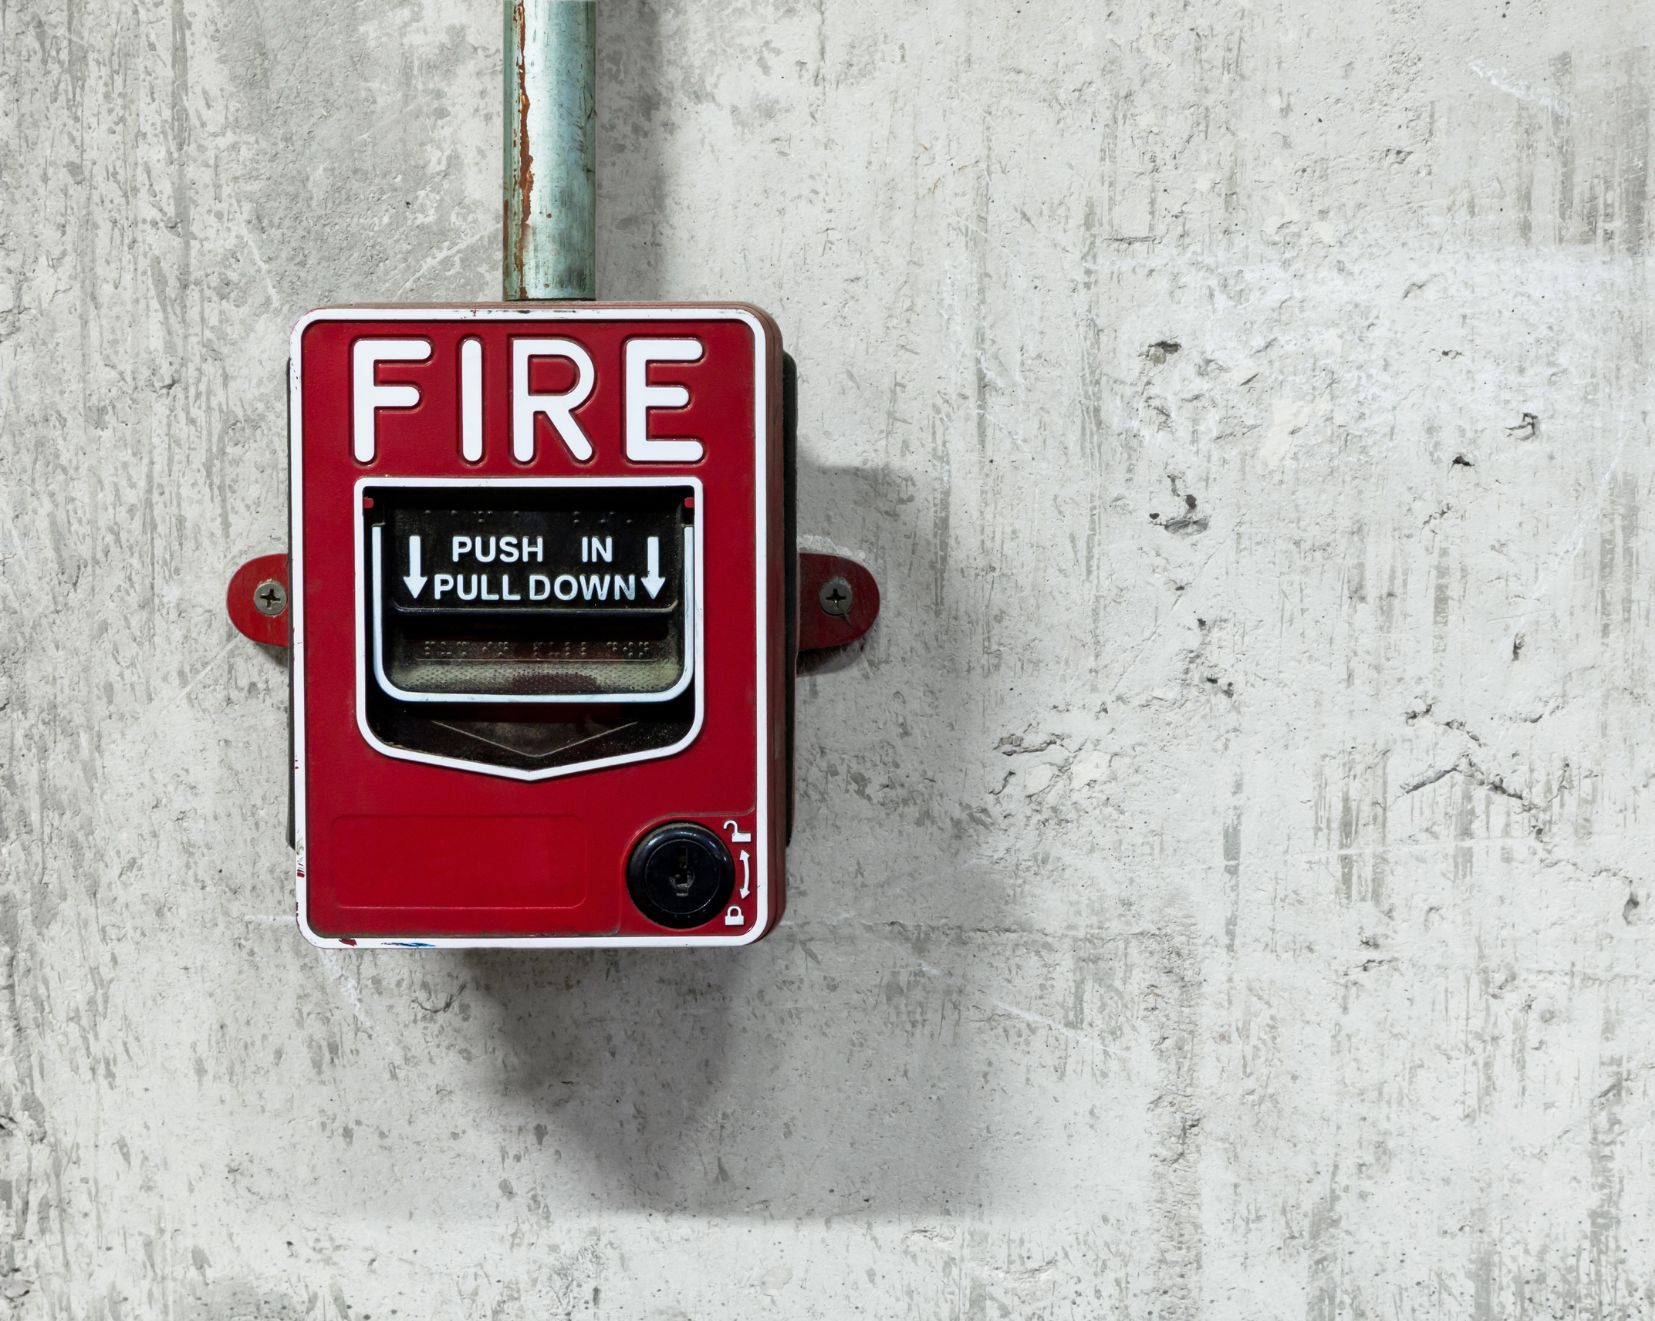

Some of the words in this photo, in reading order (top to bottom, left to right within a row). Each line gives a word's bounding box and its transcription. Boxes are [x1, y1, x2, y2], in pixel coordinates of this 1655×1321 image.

[353, 339, 704, 463] FIRE
[452, 536, 543, 562] PUSH
[581, 536, 613, 562] IN
[434, 574, 521, 600] PULL
[529, 574, 636, 601] DOWN
